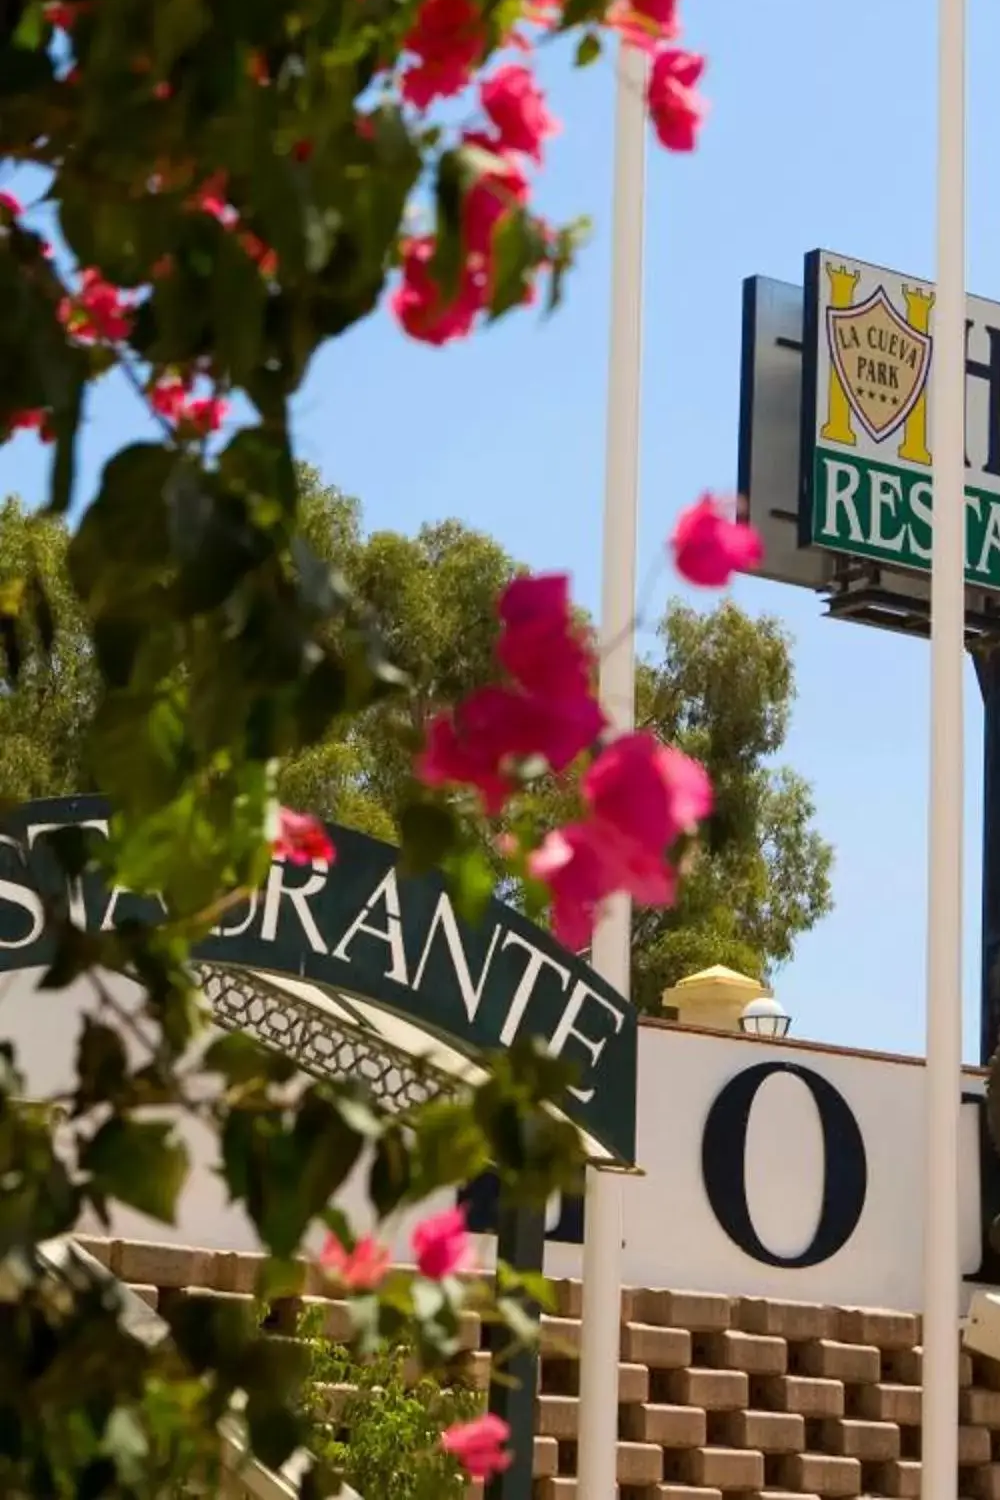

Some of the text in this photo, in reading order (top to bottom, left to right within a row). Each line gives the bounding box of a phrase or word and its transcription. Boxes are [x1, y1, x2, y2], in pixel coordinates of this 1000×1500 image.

[838, 325, 918, 370] LA CUEVA
[857, 355, 900, 390] PARK
